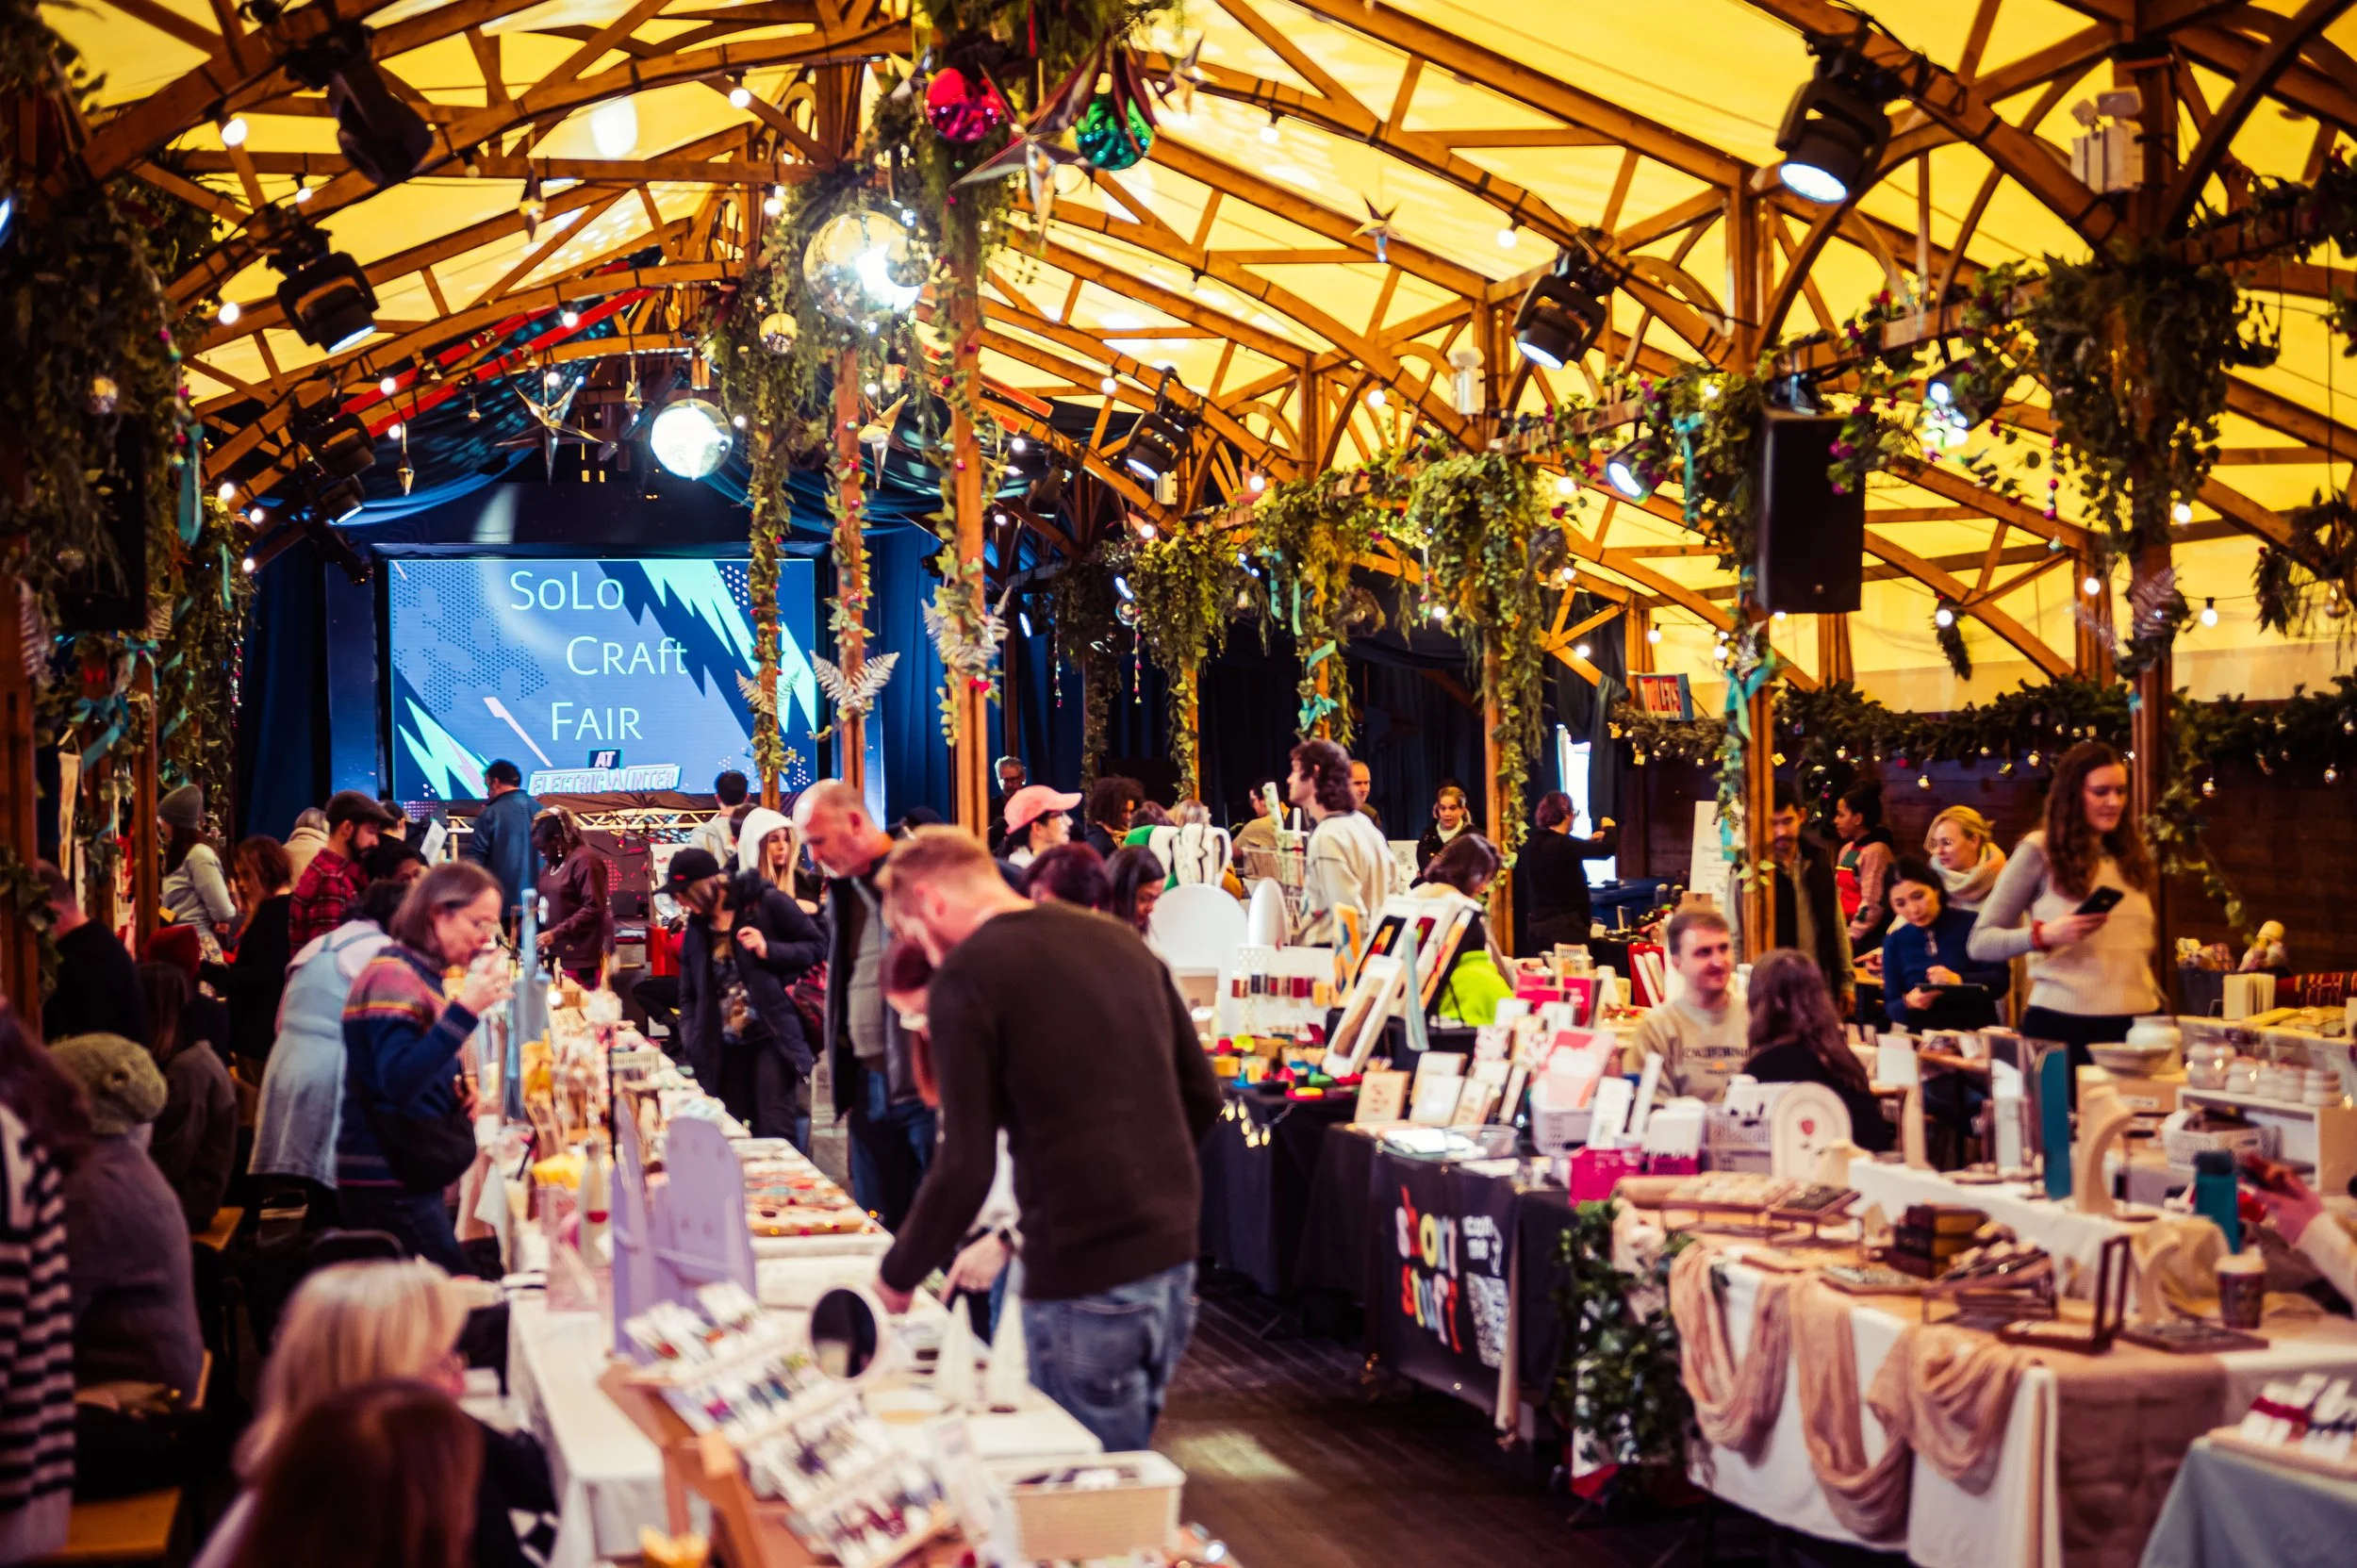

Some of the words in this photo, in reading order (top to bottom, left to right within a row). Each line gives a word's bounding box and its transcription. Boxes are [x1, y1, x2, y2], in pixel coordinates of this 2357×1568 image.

[551, 701, 643, 741] FAIR
[594, 751, 617, 767] AT
[531, 771, 604, 796] ELECTRIC
[604, 765, 676, 792] WINTER
